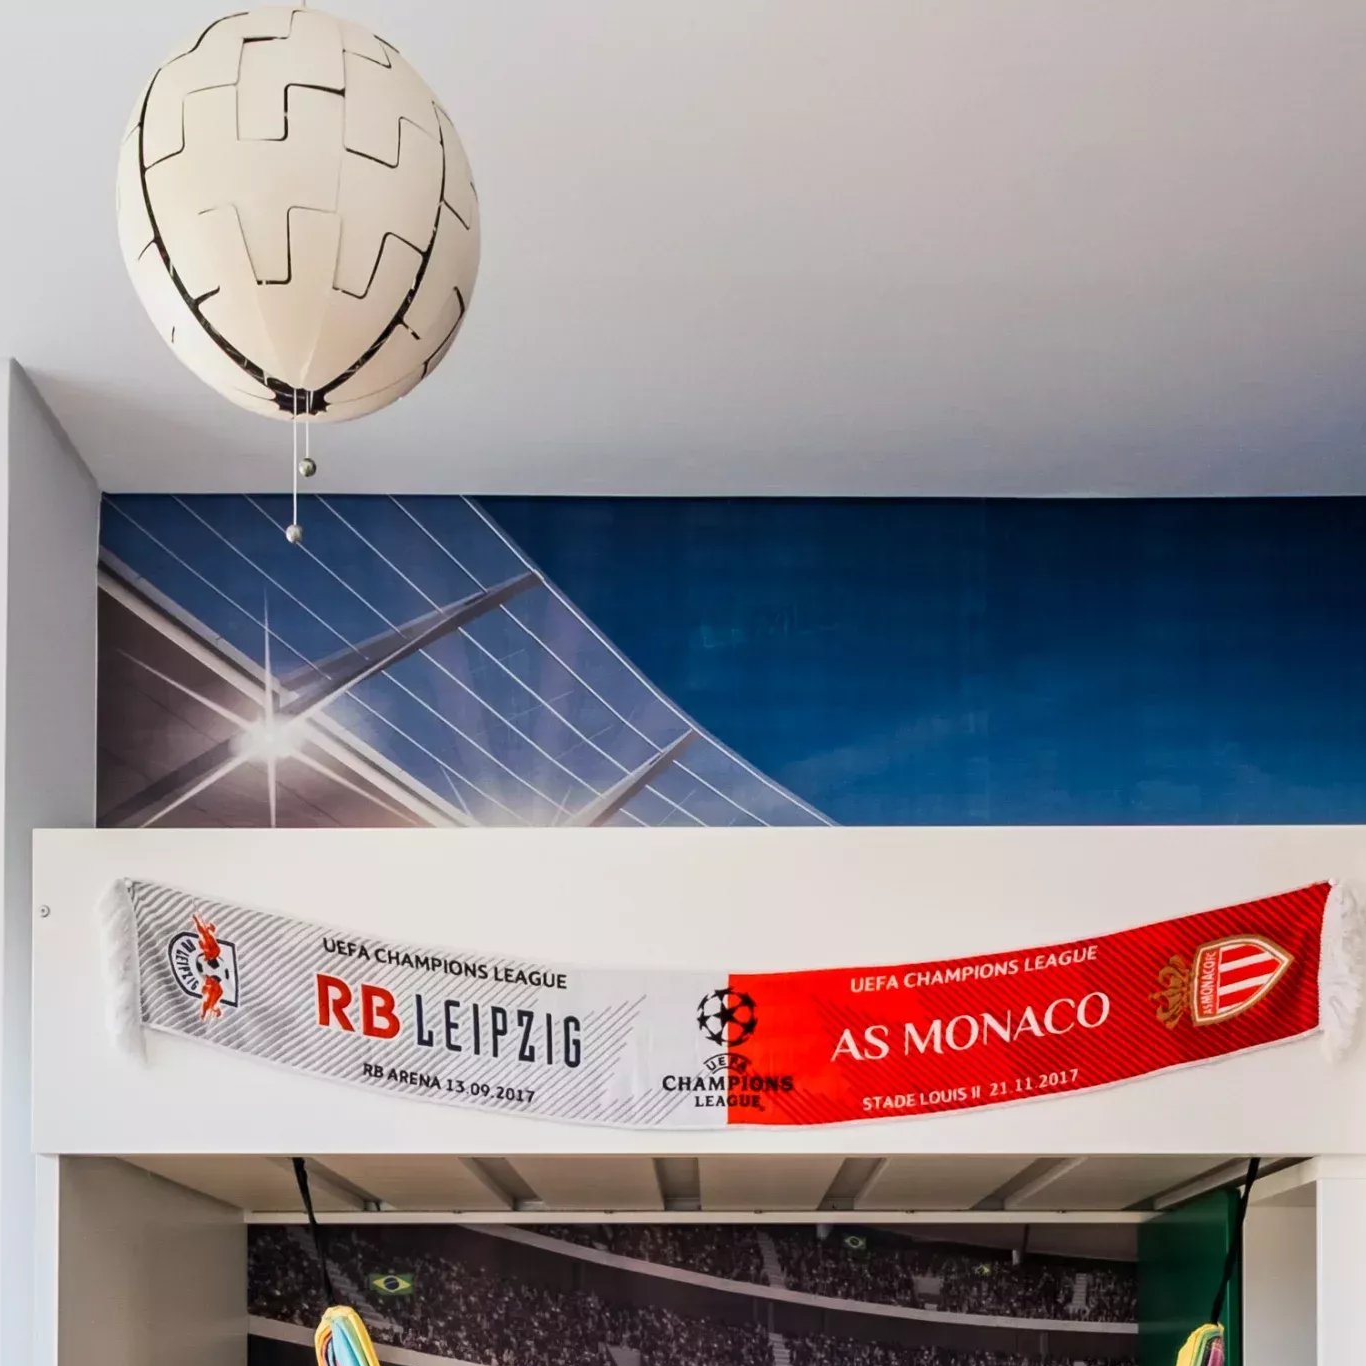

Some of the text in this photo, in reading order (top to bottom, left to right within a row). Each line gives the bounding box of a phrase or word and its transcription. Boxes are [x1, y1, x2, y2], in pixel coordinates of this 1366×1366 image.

[323, 938, 567, 989] UEFA CHAMPIONS LEAGUE
[851, 945, 1098, 993] UEFA CHAMPIONS LEAGUE
[316, 973, 581, 1068] RB LEIPZIG
[830, 991, 1110, 1062] AS MONACO
[363, 1063, 535, 1103] RB ARENA 13.09.2017
[662, 1075, 794, 1092] CHAMPIONS
[706, 1056, 748, 1072] UEFA
[695, 1095, 761, 1108] LEAGUE
[862, 1068, 1079, 1111] STADE LOUIS II 21.11.2017
